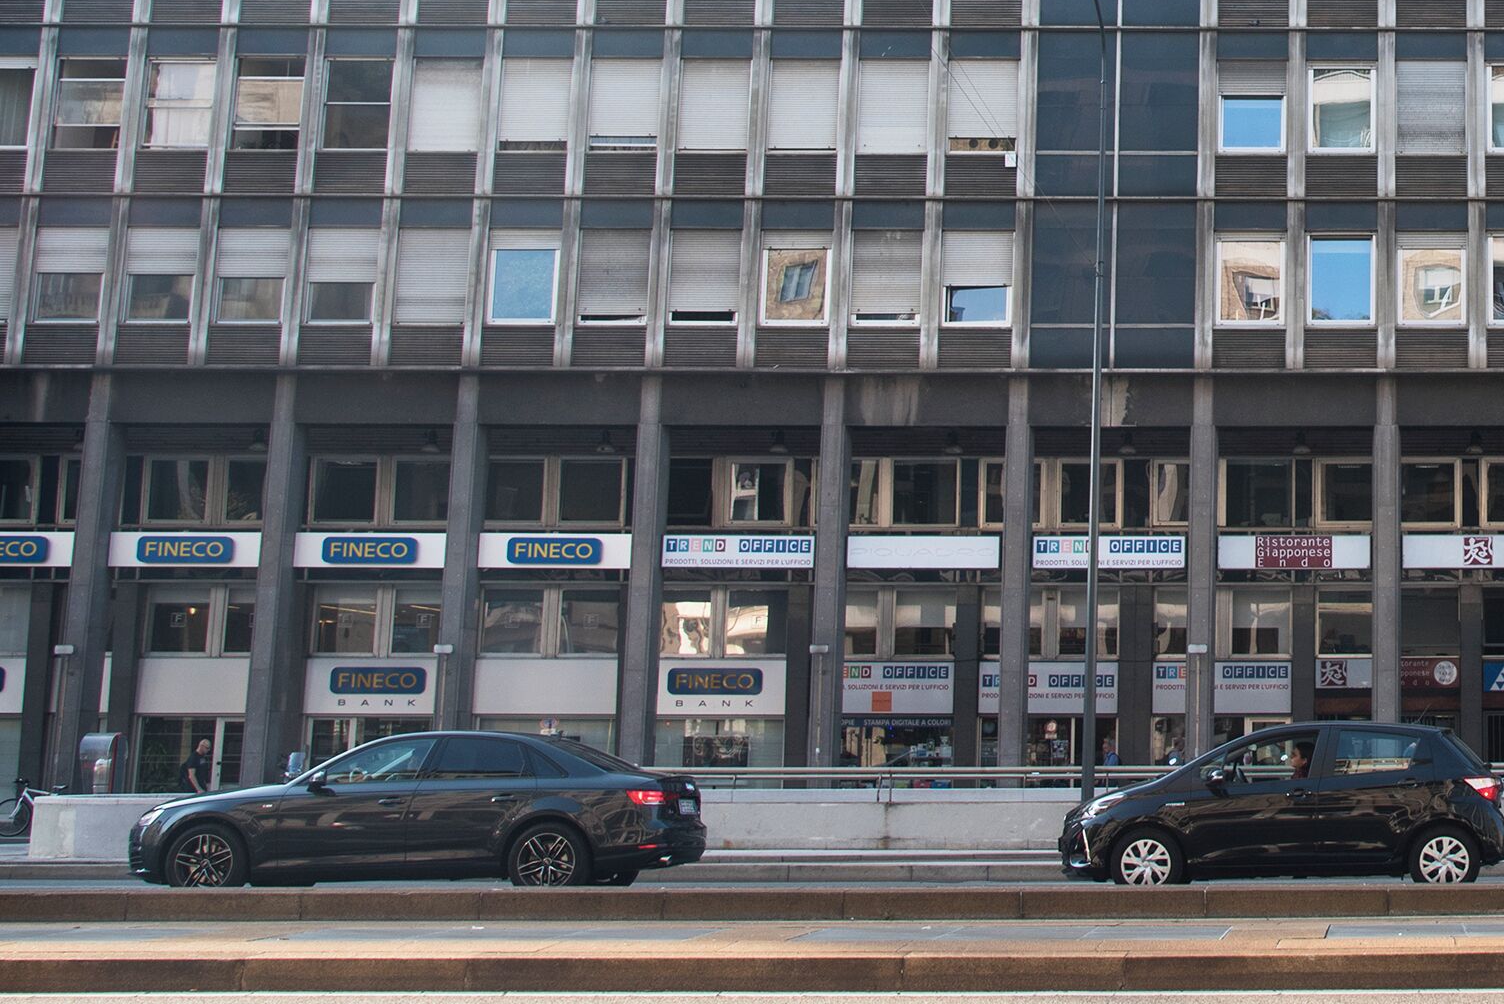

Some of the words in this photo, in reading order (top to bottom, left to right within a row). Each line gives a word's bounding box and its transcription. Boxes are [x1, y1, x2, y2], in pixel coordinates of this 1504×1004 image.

[667, 539, 725, 552] TREND
[739, 539, 811, 553] OFFICE
[1037, 539, 1090, 553] TREN
[1110, 540, 1182, 553] OFFICE
[1257, 537, 1330, 546] Ristorante
[145, 541, 224, 557] FINECO
[330, 542, 408, 558] FINECO
[515, 543, 593, 559] FINECO
[1257, 547, 1330, 558] Giapponese
[883, 666, 949, 678] OFFICE
[1223, 666, 1288, 678] OFFICE
[338, 673, 416, 688] FINECO
[676, 674, 754, 689] FINECO
[1049, 675, 1114, 687] OFFCE
